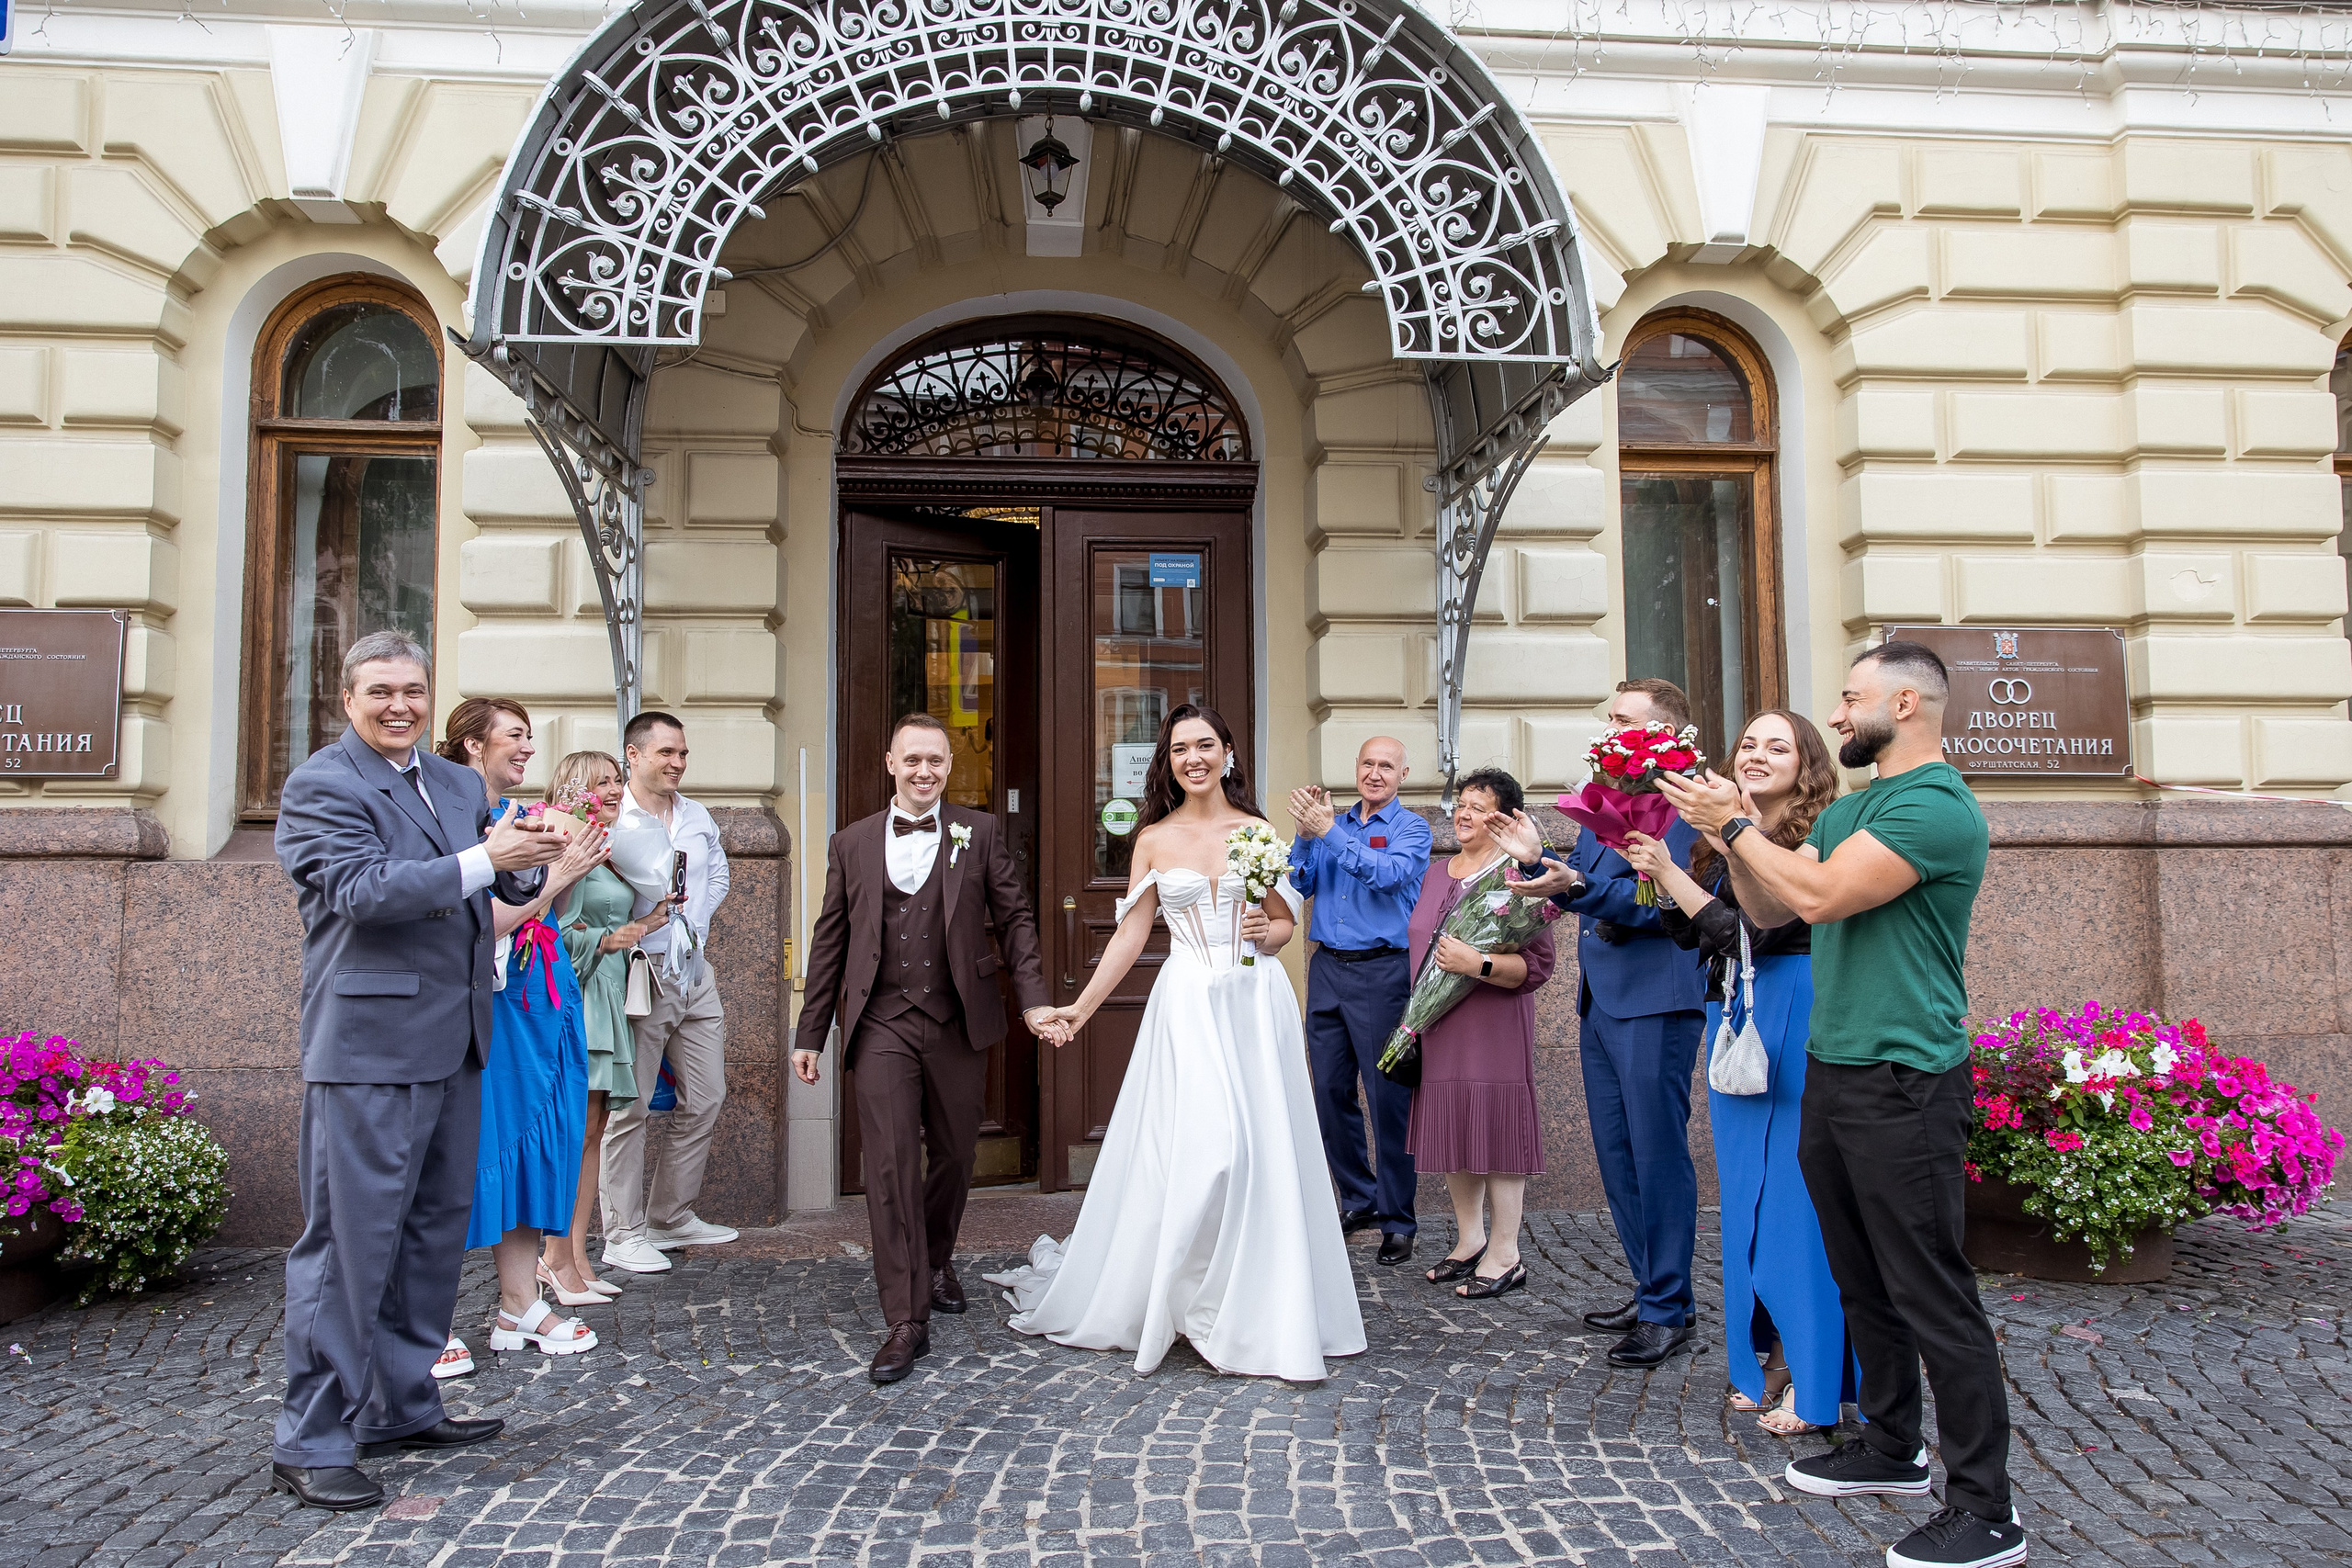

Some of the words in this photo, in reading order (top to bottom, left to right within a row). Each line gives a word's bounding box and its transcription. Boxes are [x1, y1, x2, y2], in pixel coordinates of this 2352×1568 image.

[1968, 712, 2057, 730] ДВОРЕЦ
[1, 733, 92, 752] ТАНИЯ
[5, 758, 21, 768] 52
[2046, 760, 2060, 769] 52
